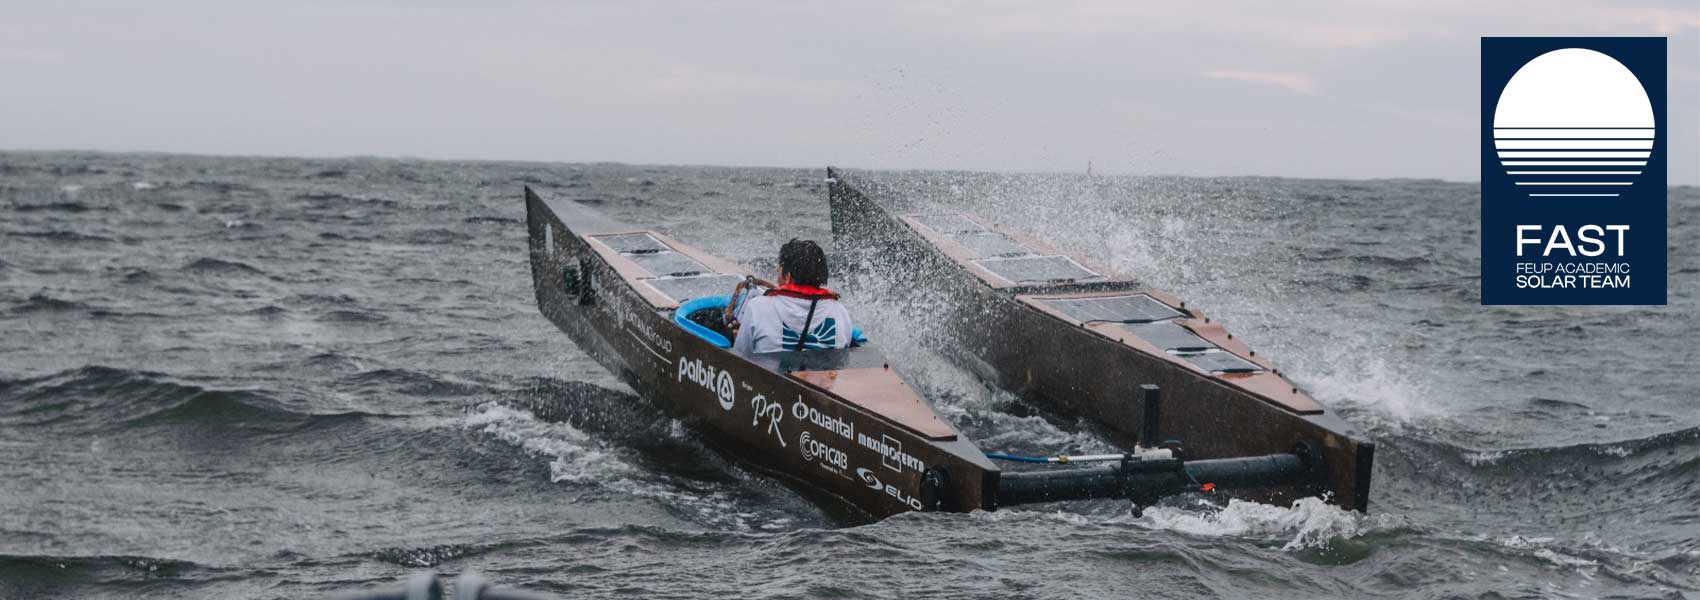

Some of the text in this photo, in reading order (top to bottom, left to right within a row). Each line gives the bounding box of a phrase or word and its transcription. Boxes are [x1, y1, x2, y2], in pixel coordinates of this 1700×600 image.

[678, 356, 716, 393] palbit
[810, 407, 854, 441] Quantal
[799, 431, 848, 470] COFICAB
